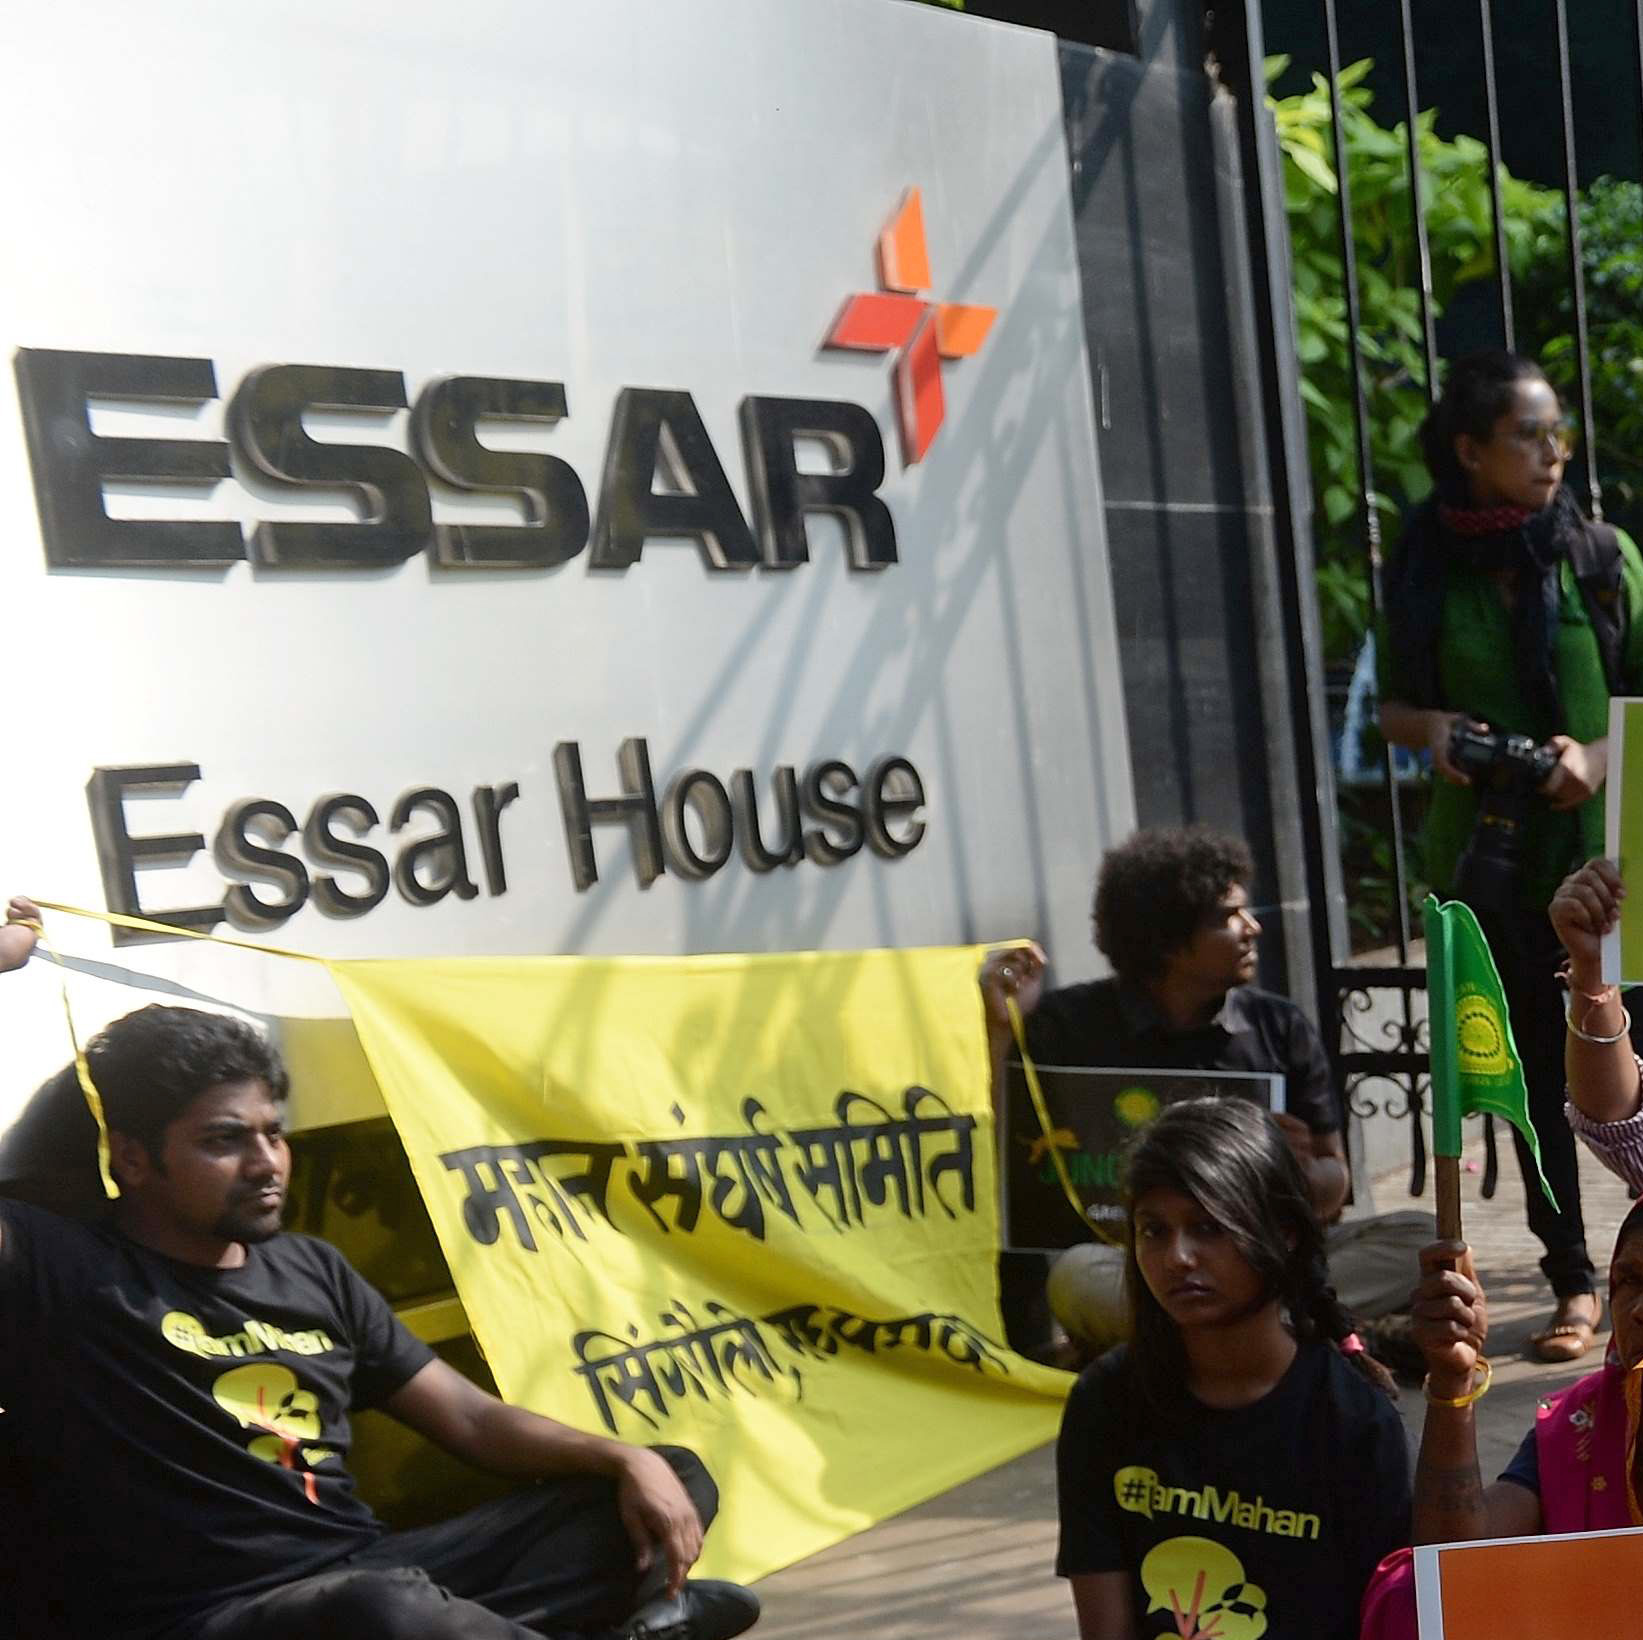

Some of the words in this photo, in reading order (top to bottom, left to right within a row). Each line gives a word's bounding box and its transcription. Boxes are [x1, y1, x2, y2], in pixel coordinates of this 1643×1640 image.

[14, 346, 901, 570] ESSAR
[85, 760, 520, 948] Essar
[553, 737, 928, 892] House
